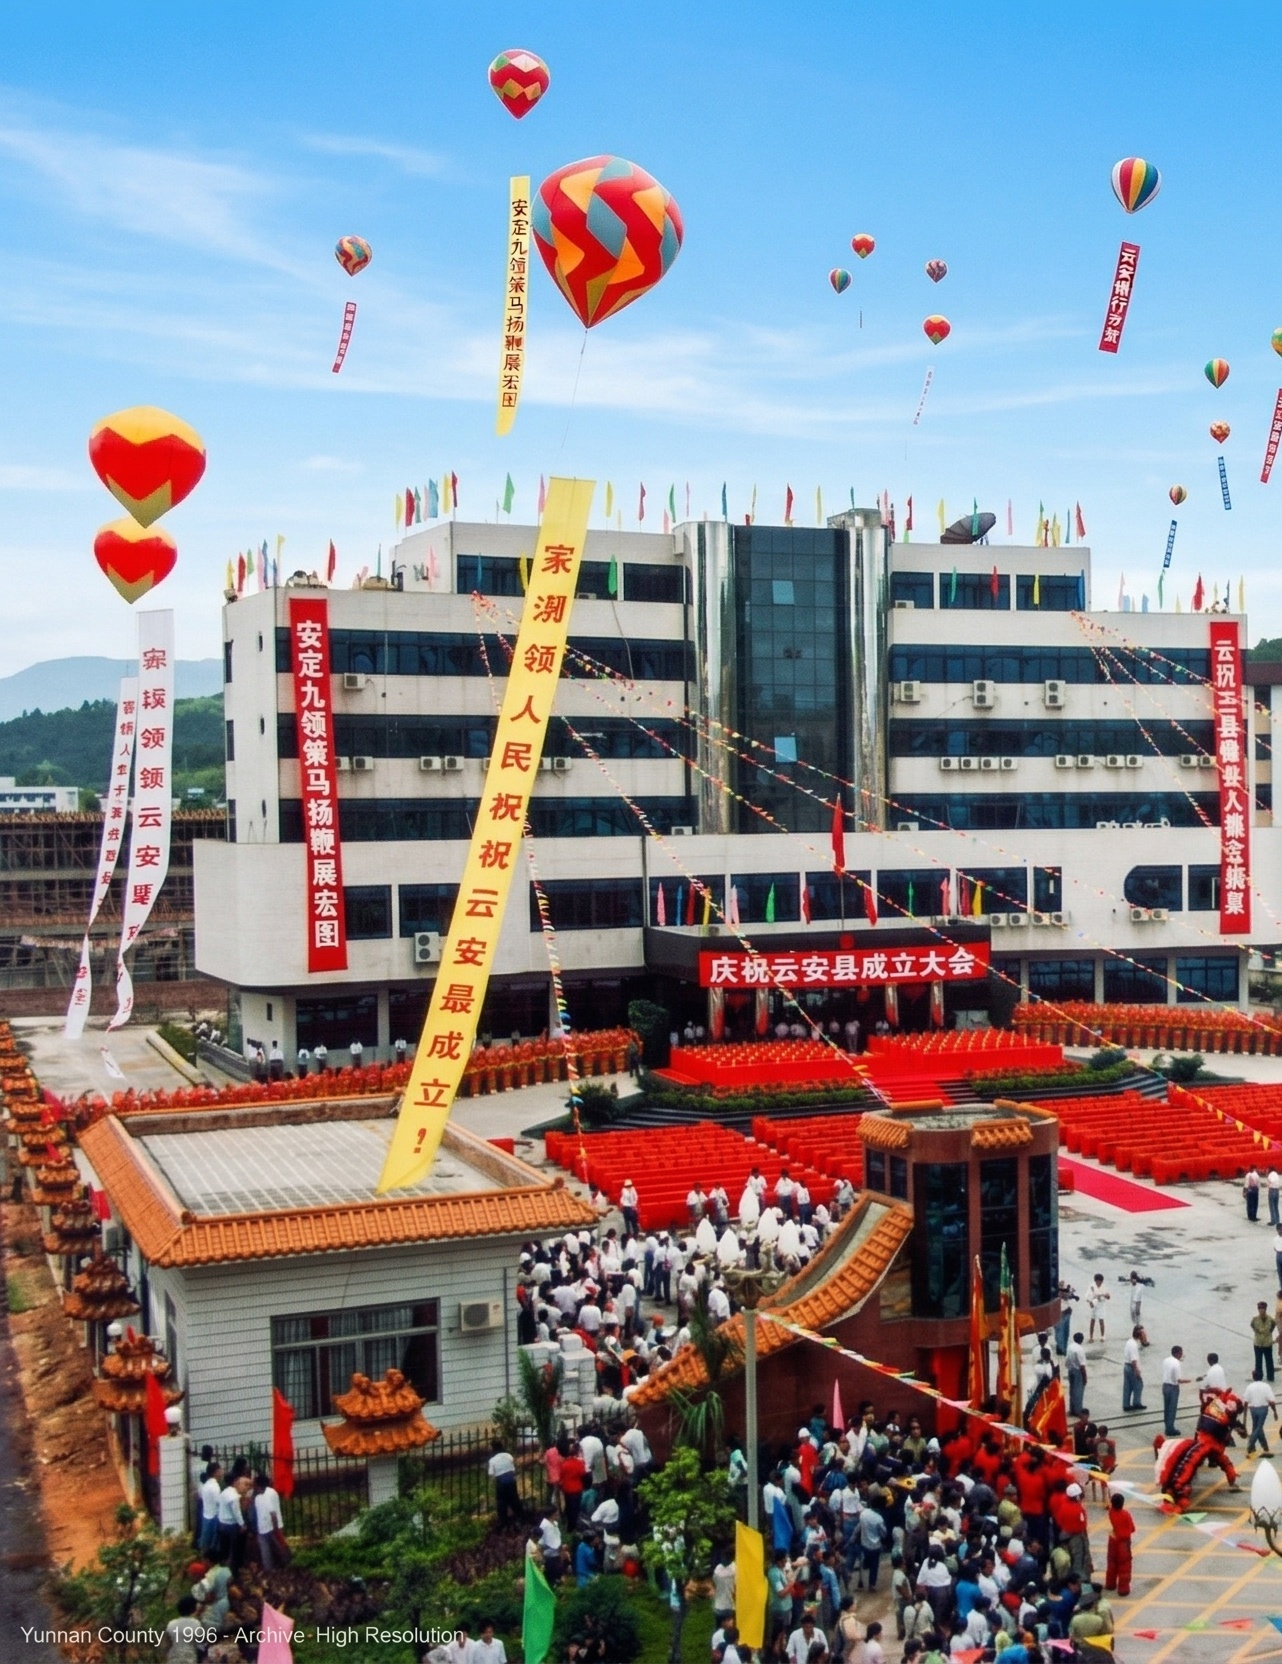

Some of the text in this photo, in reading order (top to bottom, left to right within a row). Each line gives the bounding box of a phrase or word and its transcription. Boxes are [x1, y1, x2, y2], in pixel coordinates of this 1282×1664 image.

[296, 619, 339, 949] 安定九领策马扬鞭展宏图
[709, 949, 976, 983] 庆祝云安县成立大会
